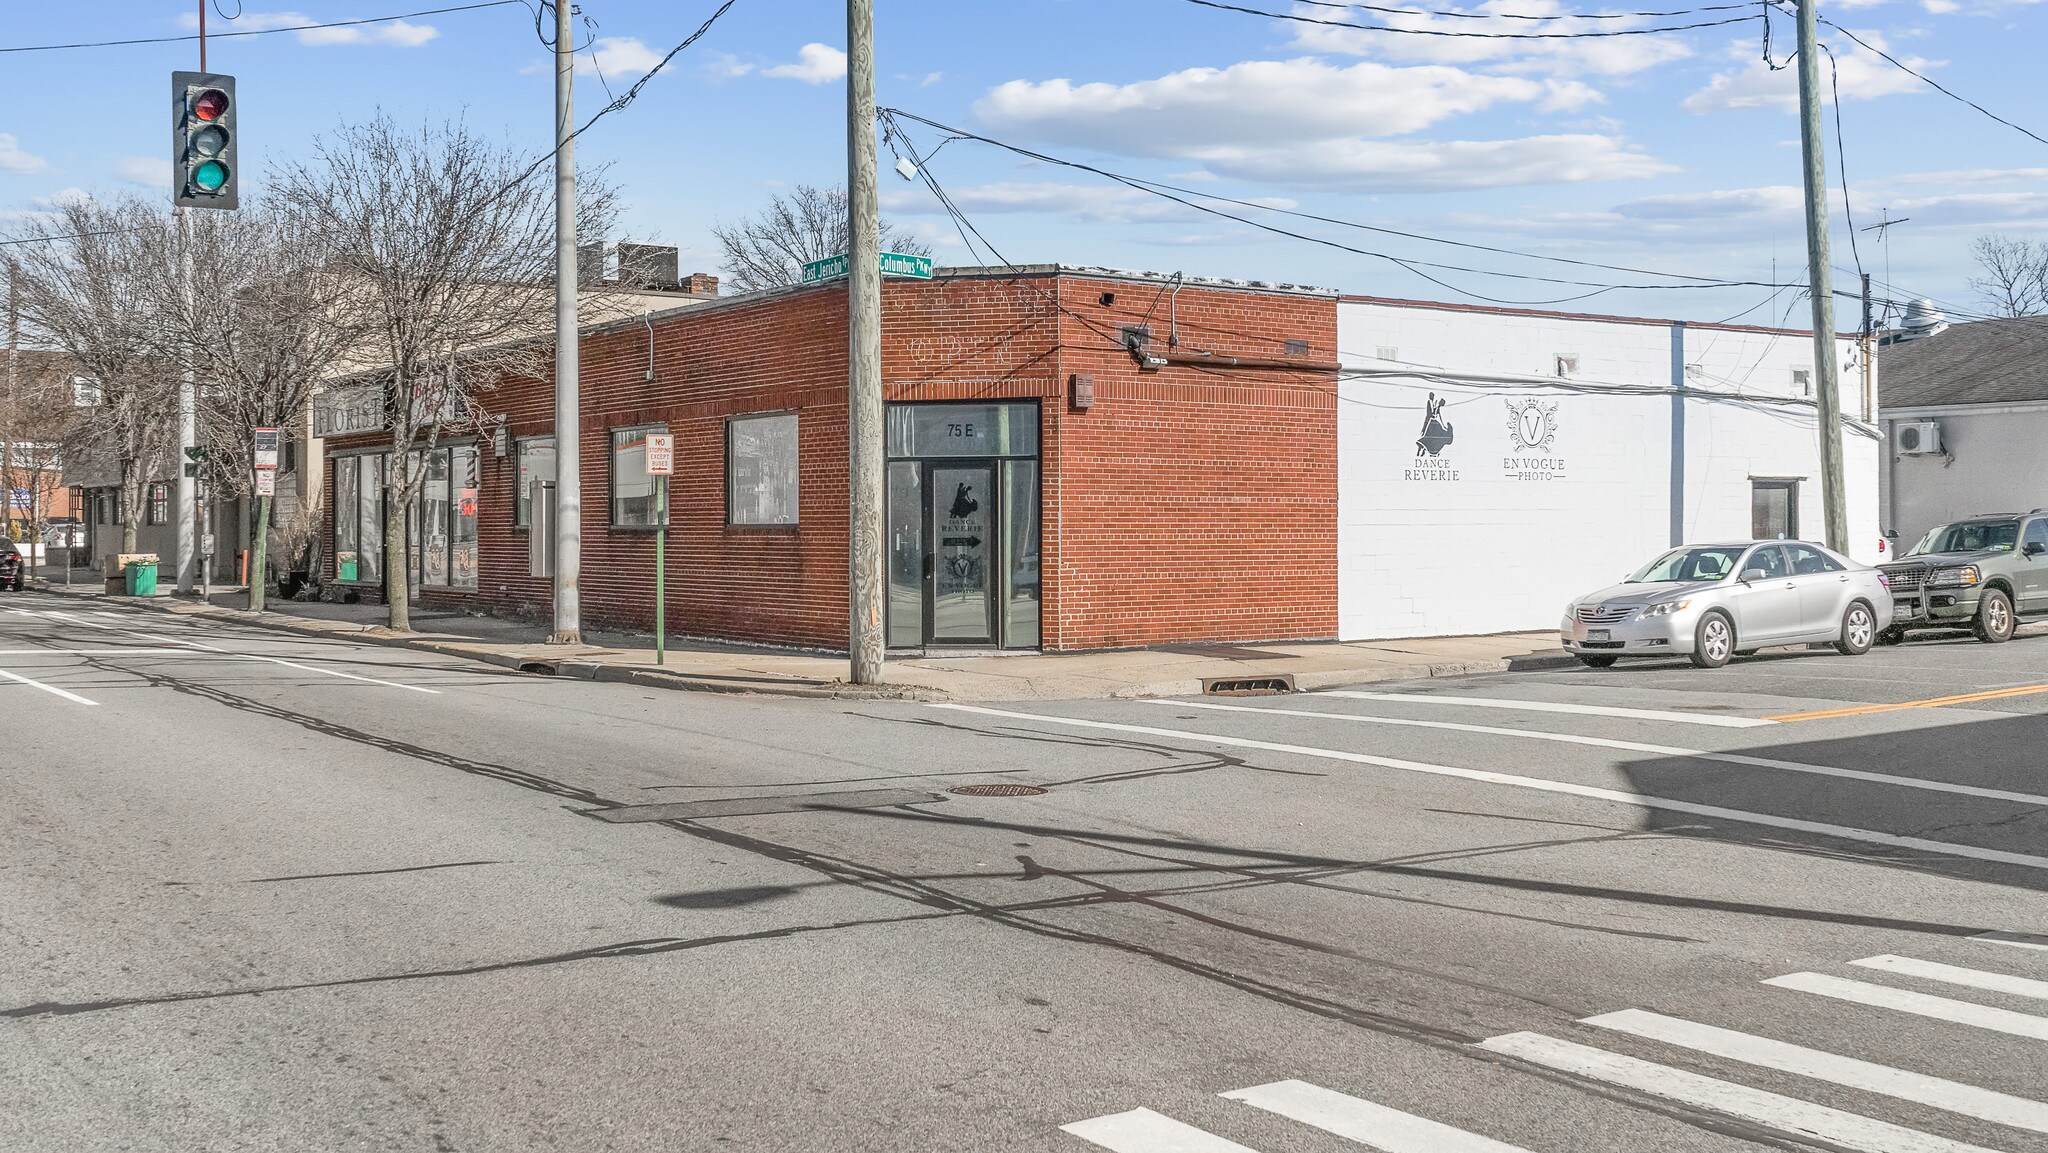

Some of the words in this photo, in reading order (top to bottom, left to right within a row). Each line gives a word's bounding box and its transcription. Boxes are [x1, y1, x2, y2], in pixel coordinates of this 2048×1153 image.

[803, 264, 816, 281] East
[818, 259, 843, 278] Jericho
[880, 254, 916, 274] Columbus
[317, 398, 381, 434] FLORIST
[948, 423, 962, 437] 75
[965, 423, 974, 437] E
[1524, 416, 1540, 441] V
[1414, 458, 1450, 468] DANCE
[1503, 457, 1520, 469] EN
[1522, 458, 1565, 470] VOGUE
[1404, 469, 1460, 481] REVERIE
[1518, 471, 1553, 481] PHOTO
[957, 562, 969, 575] V
